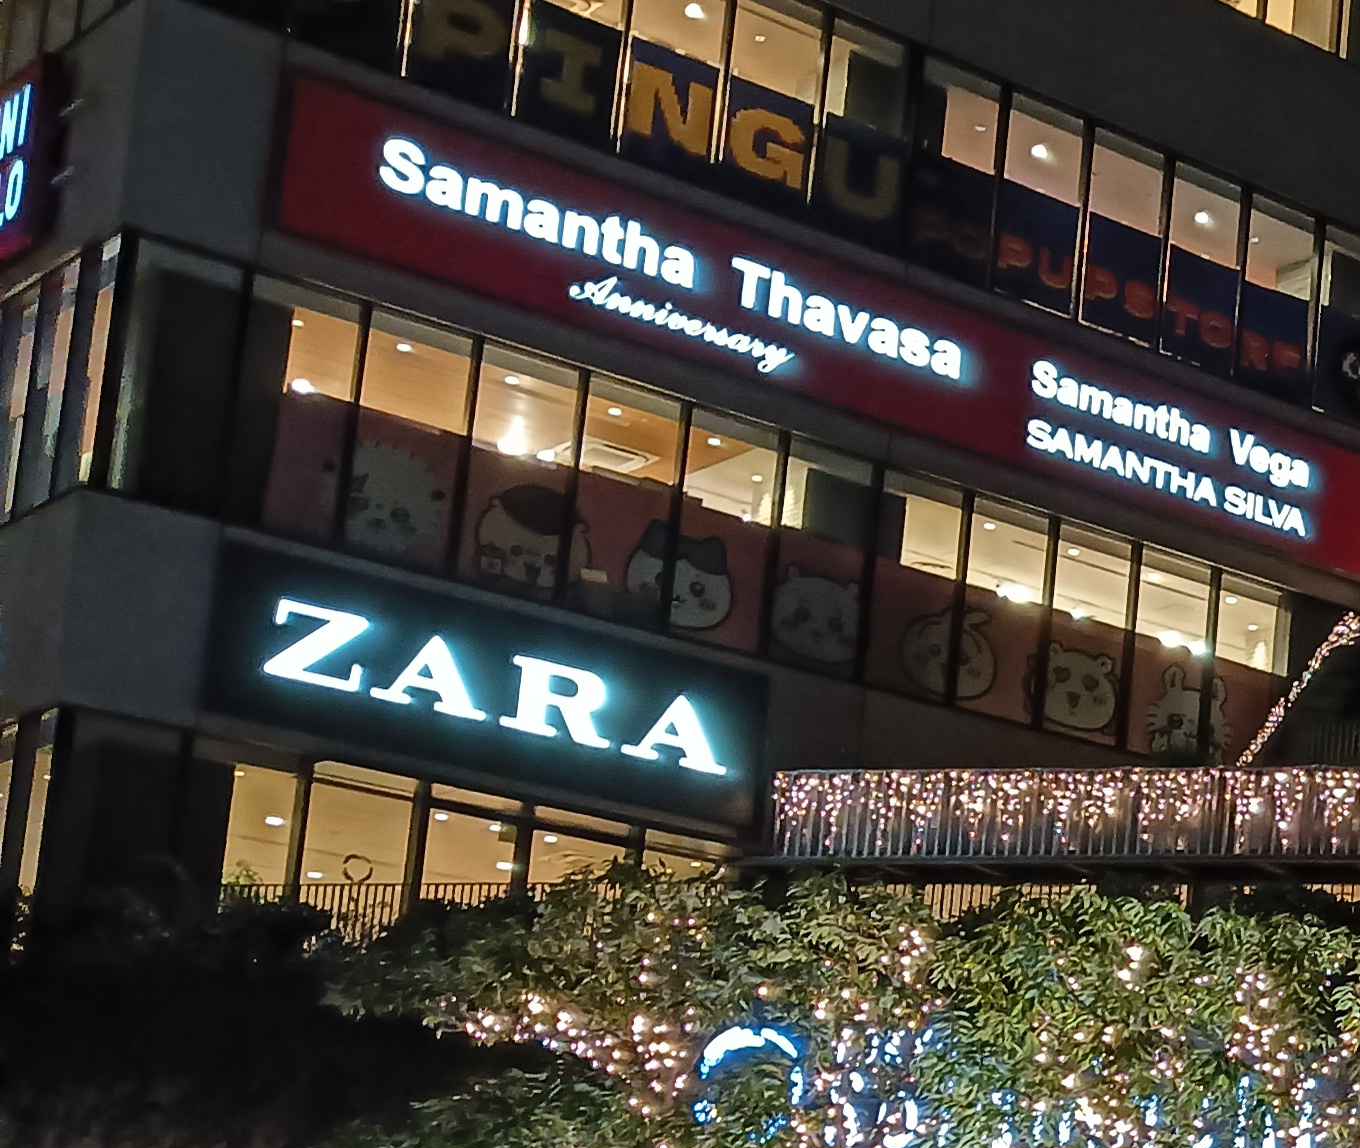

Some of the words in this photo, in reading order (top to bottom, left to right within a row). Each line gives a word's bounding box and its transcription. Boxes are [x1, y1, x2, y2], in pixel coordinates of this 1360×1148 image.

[416, 0, 902, 223] PINGU
[379, 138, 697, 290] Samantha
[731, 257, 963, 382] Thavasa
[568, 275, 796, 374] Anniversary
[1025, 419, 1217, 507] SAMANTHA
[1223, 486, 1307, 538] SILVA
[1031, 360, 1212, 454] Samantha
[1229, 428, 1311, 488] Vega
[263, 597, 727, 776] ZARA
